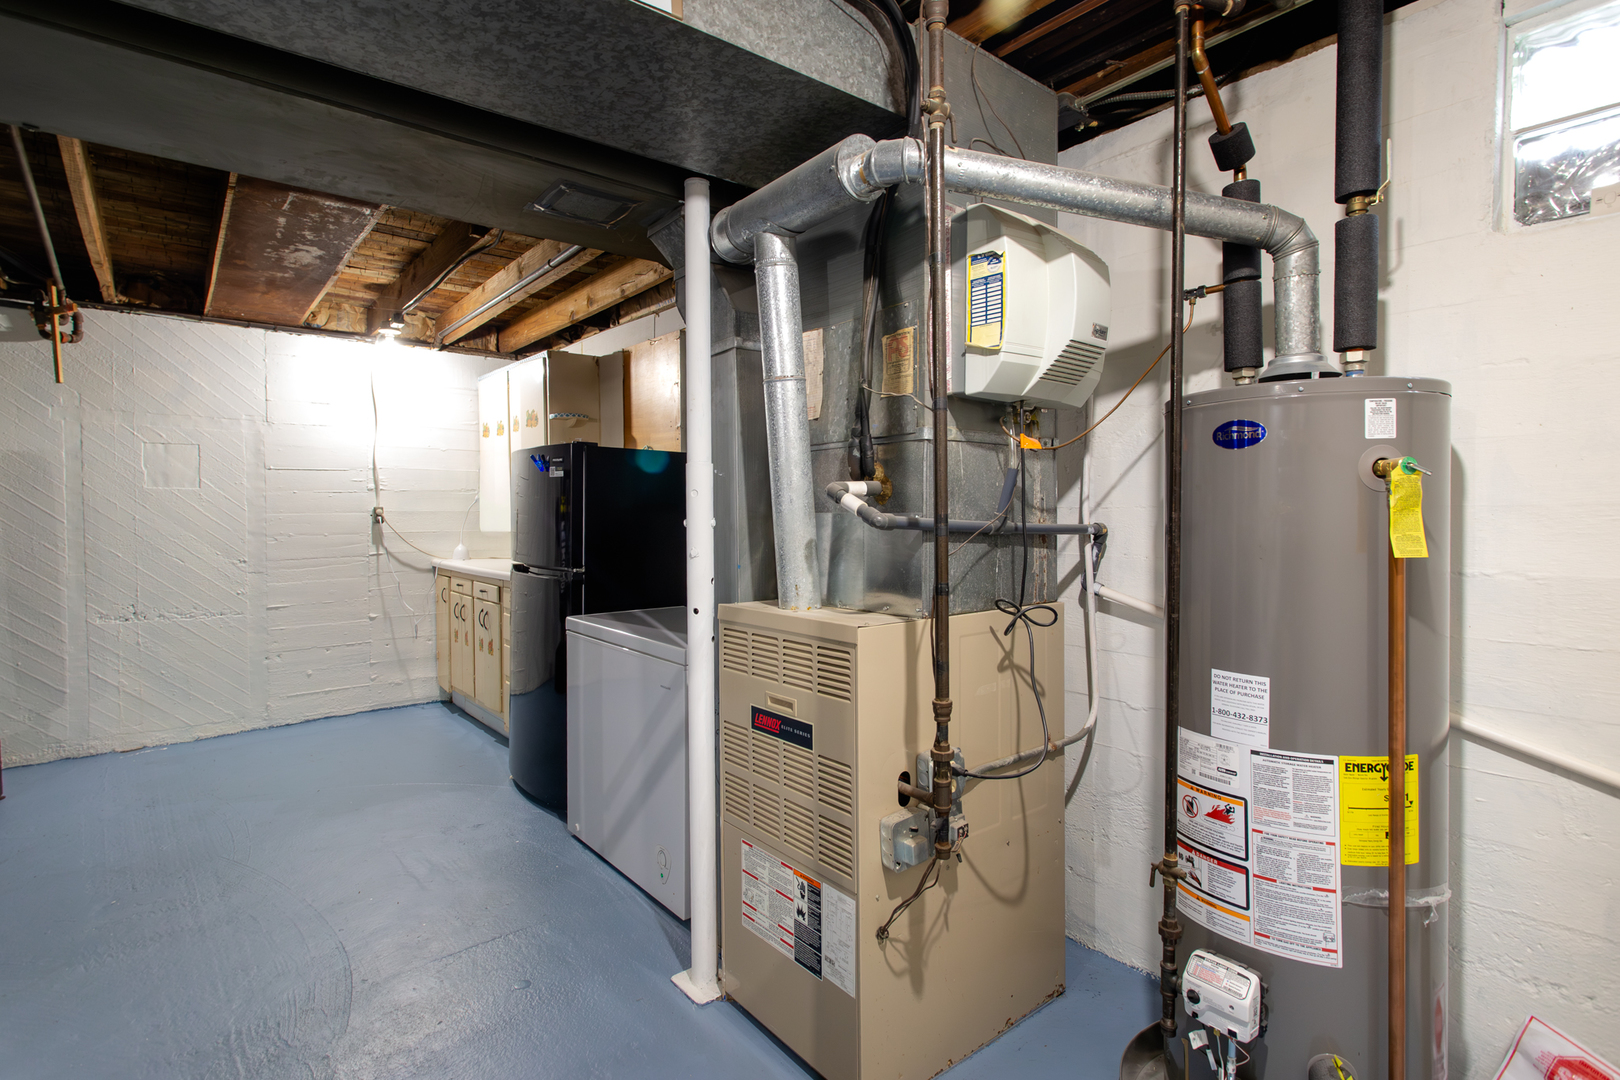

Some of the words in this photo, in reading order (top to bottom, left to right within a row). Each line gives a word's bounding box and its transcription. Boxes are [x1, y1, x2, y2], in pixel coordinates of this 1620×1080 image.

[1216, 427, 1262, 441] Richmond
[1232, 676, 1254, 685] RETURN
[1237, 691, 1265, 700] PURCHASE
[1212, 706, 1268, 724] 1-800-432-8373
[754, 713, 782, 730] LENNOX
[780, 724, 793, 733] ELITE
[793, 729, 811, 738] SERIES
[1195, 786, 1222, 800] WARNING
[1195, 850, 1218, 865] DANGER
